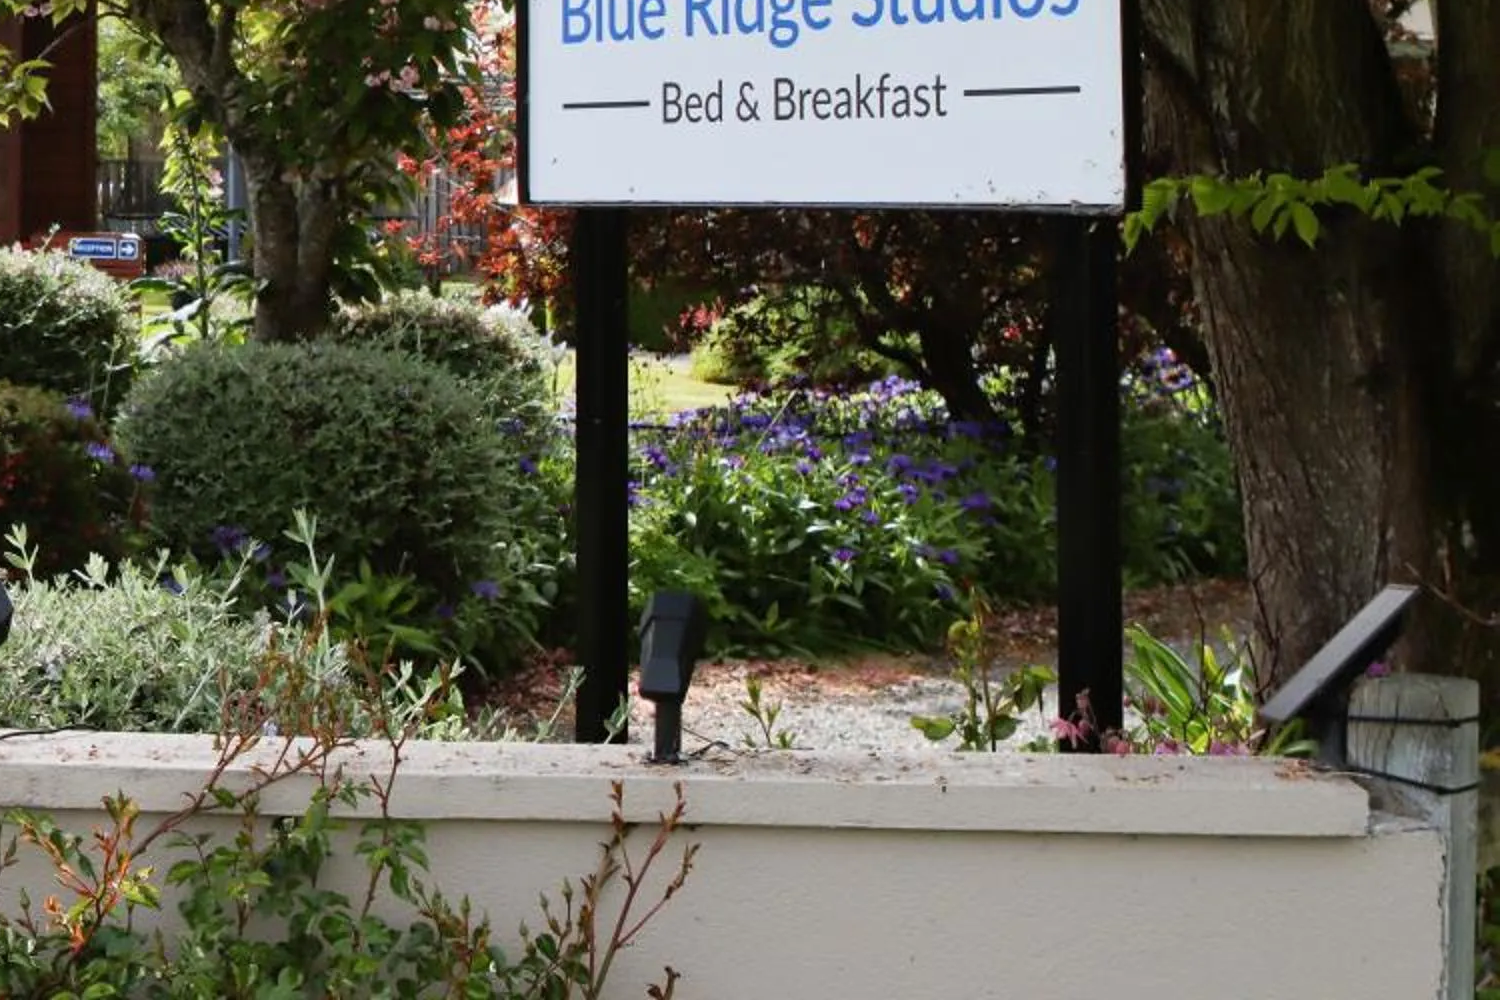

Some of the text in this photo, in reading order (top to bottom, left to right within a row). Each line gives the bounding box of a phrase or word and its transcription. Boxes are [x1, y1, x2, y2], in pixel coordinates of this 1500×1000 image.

[662, 73, 948, 124] Bed & Breakfast
